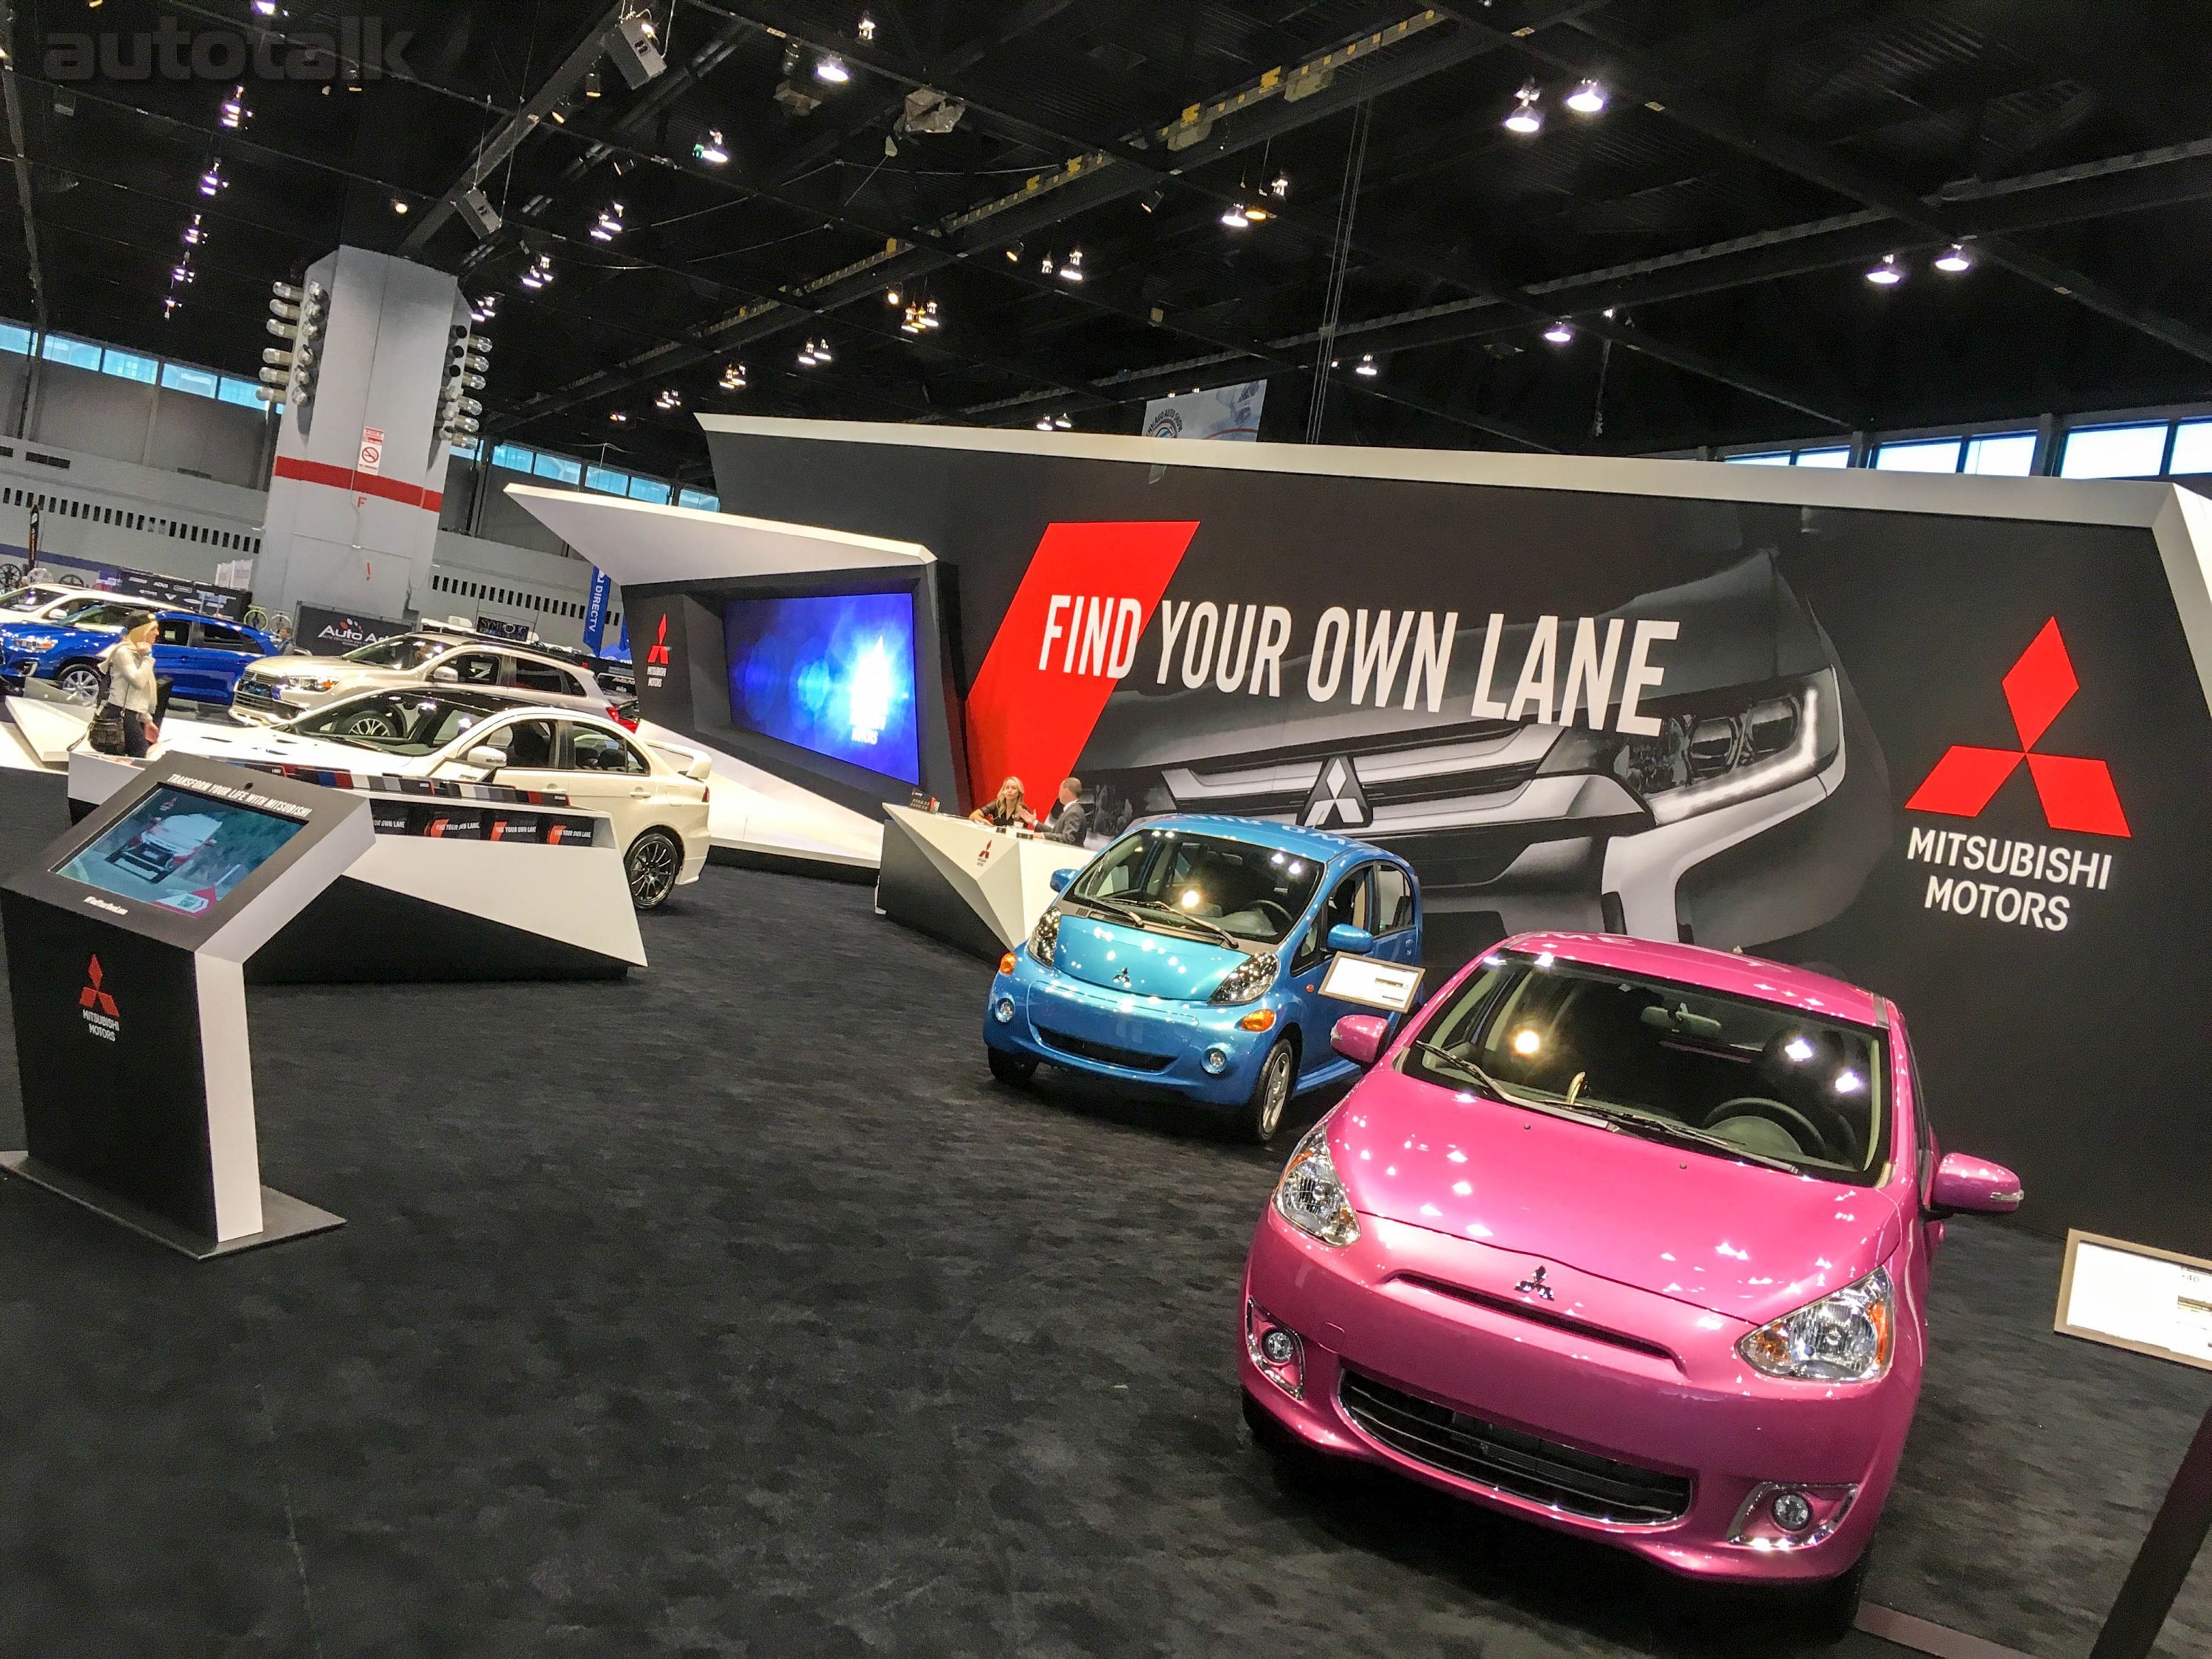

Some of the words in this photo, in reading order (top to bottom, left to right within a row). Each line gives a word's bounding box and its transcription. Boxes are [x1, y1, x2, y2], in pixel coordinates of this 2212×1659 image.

[1164, 408, 1175, 418] AUTO
[1174, 413, 1183, 432] SHOW
[588, 585, 603, 632] DIRECTV
[318, 625, 363, 640] Auto
[1038, 594, 1142, 679] FIND
[1156, 599, 1292, 698] YOUR
[1307, 606, 1458, 713] OWN
[1471, 613, 1680, 737] LANE
[167, 773, 212, 791] TRANSFORM
[209, 784, 232, 797] YOUR
[229, 789, 246, 801] LIFE
[245, 793, 266, 806] WITH
[265, 799, 313, 818] MITSUBISHI
[1907, 827, 2112, 891] MITSUBISHI
[1924, 875, 2070, 932] MOTORS
[83, 1009, 119, 1032] MITSUBISHI
[88, 1023, 116, 1042] MOTORS
